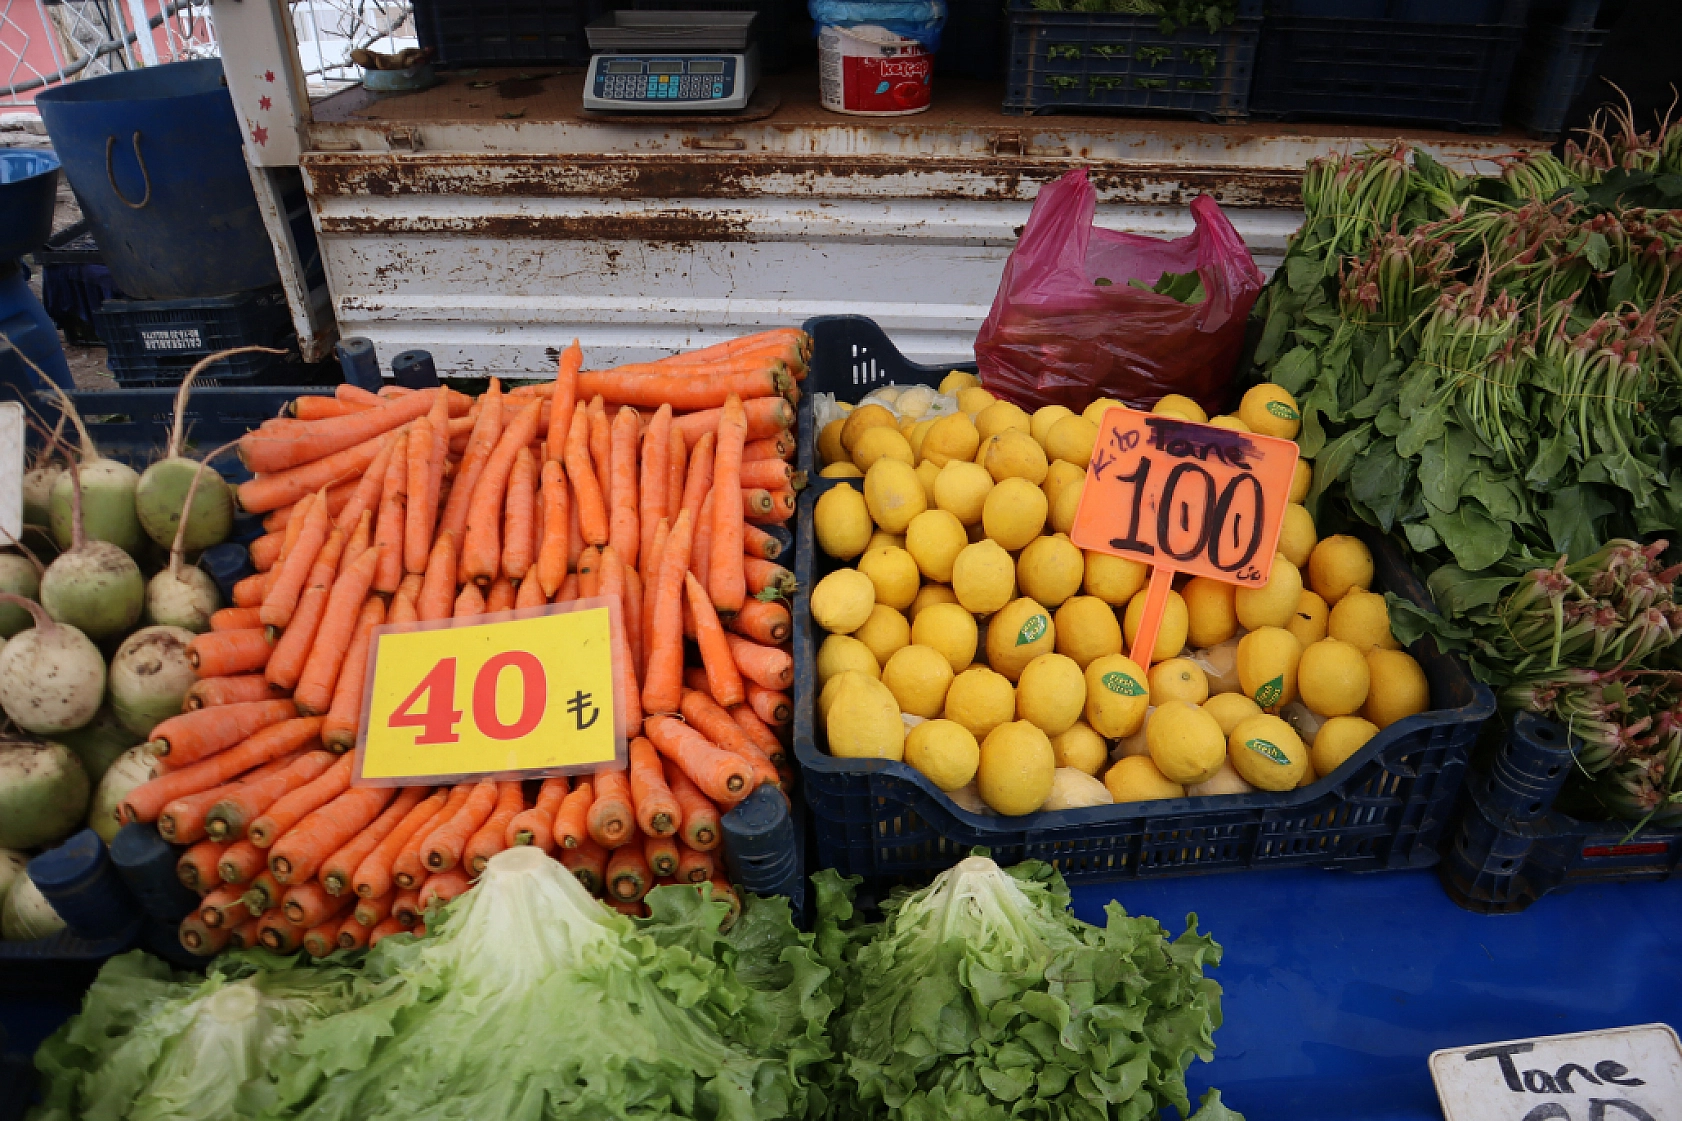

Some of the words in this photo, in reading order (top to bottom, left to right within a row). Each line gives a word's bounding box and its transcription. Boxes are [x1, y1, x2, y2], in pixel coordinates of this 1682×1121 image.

[1109, 456, 1265, 572] 100
[387, 650, 548, 746] 40
[1109, 674, 1134, 687] Fresh
[1253, 741, 1278, 758] Fresh
[1464, 1042, 1647, 1094] Tane
